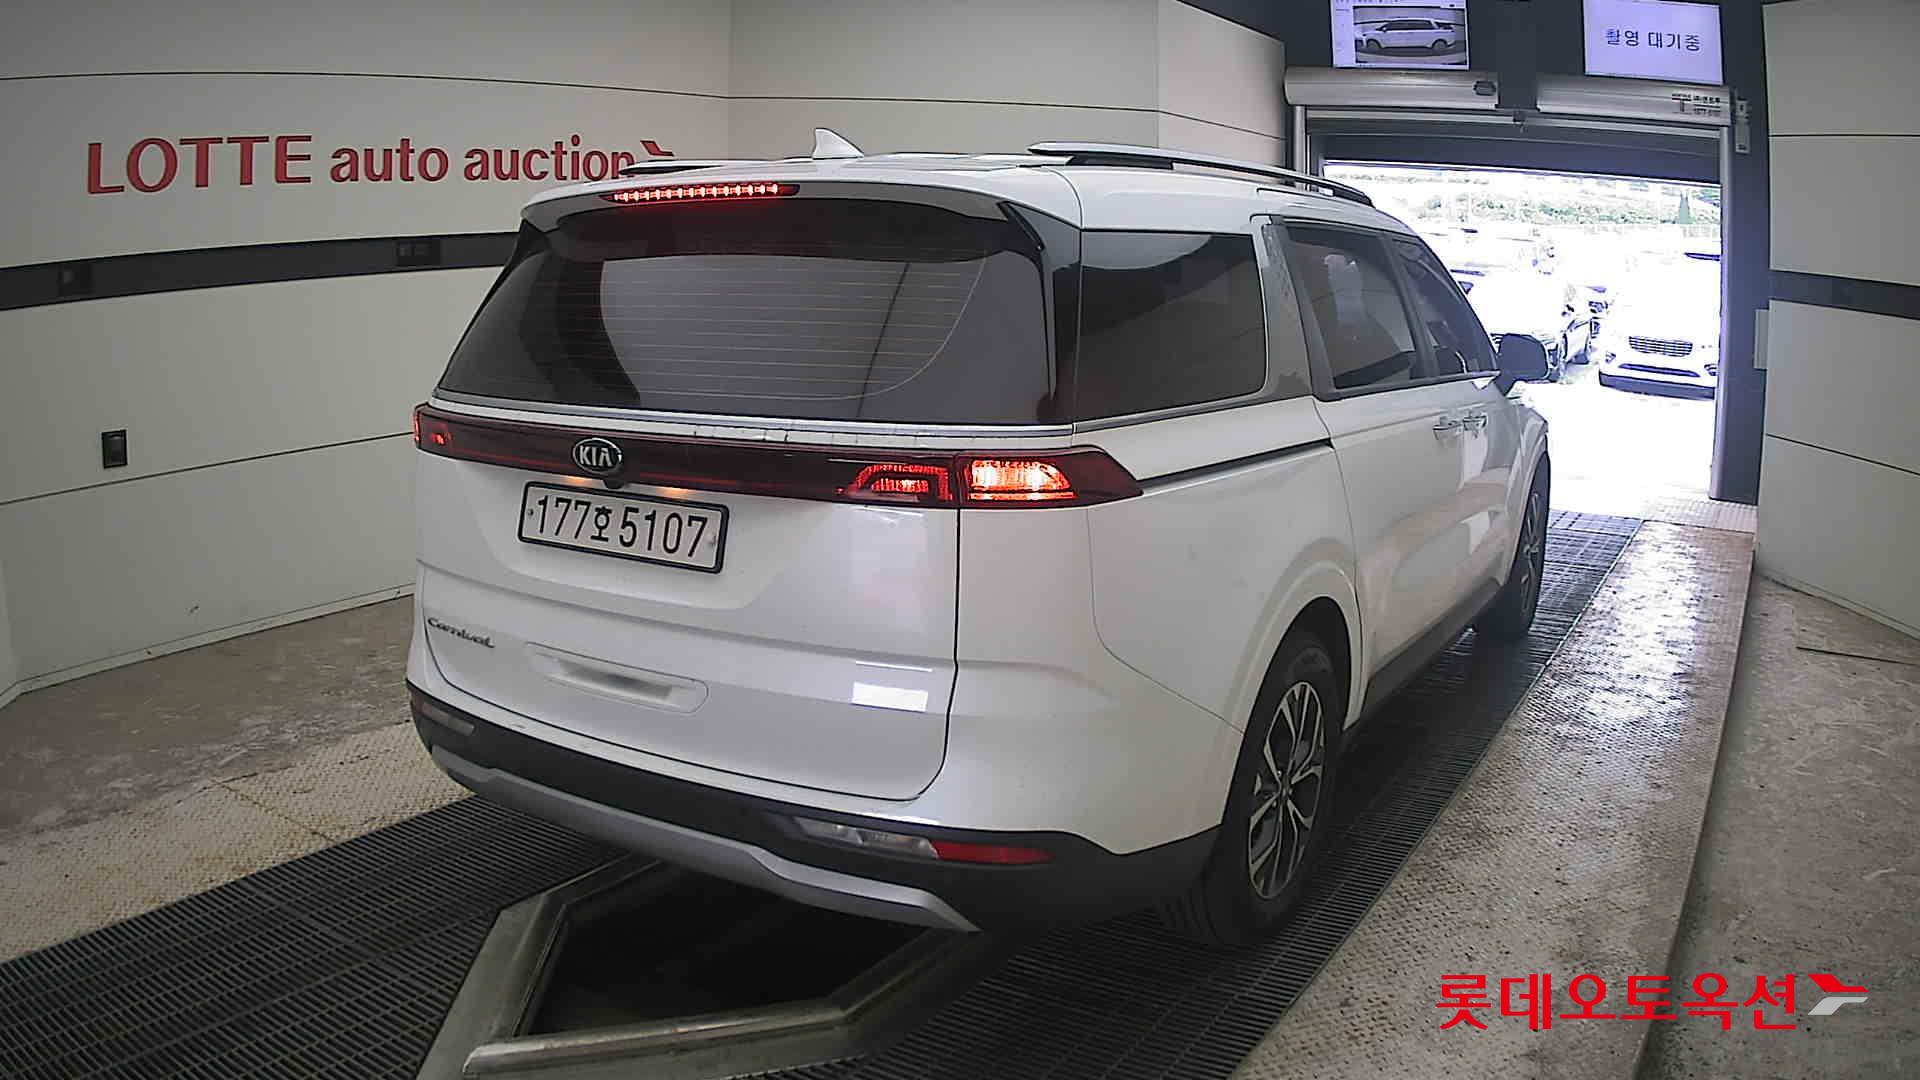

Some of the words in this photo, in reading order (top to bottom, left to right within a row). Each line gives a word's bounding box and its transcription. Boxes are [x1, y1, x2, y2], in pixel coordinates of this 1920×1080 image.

[1605, 29, 1640, 47] 촬영
[1648, 30, 1702, 52] 대기중
[87, 135, 312, 194] LOTTE
[330, 138, 449, 182] auto
[463, 134, 635, 182] auction
[578, 445, 614, 468] KIA
[427, 617, 496, 649] Carnival
